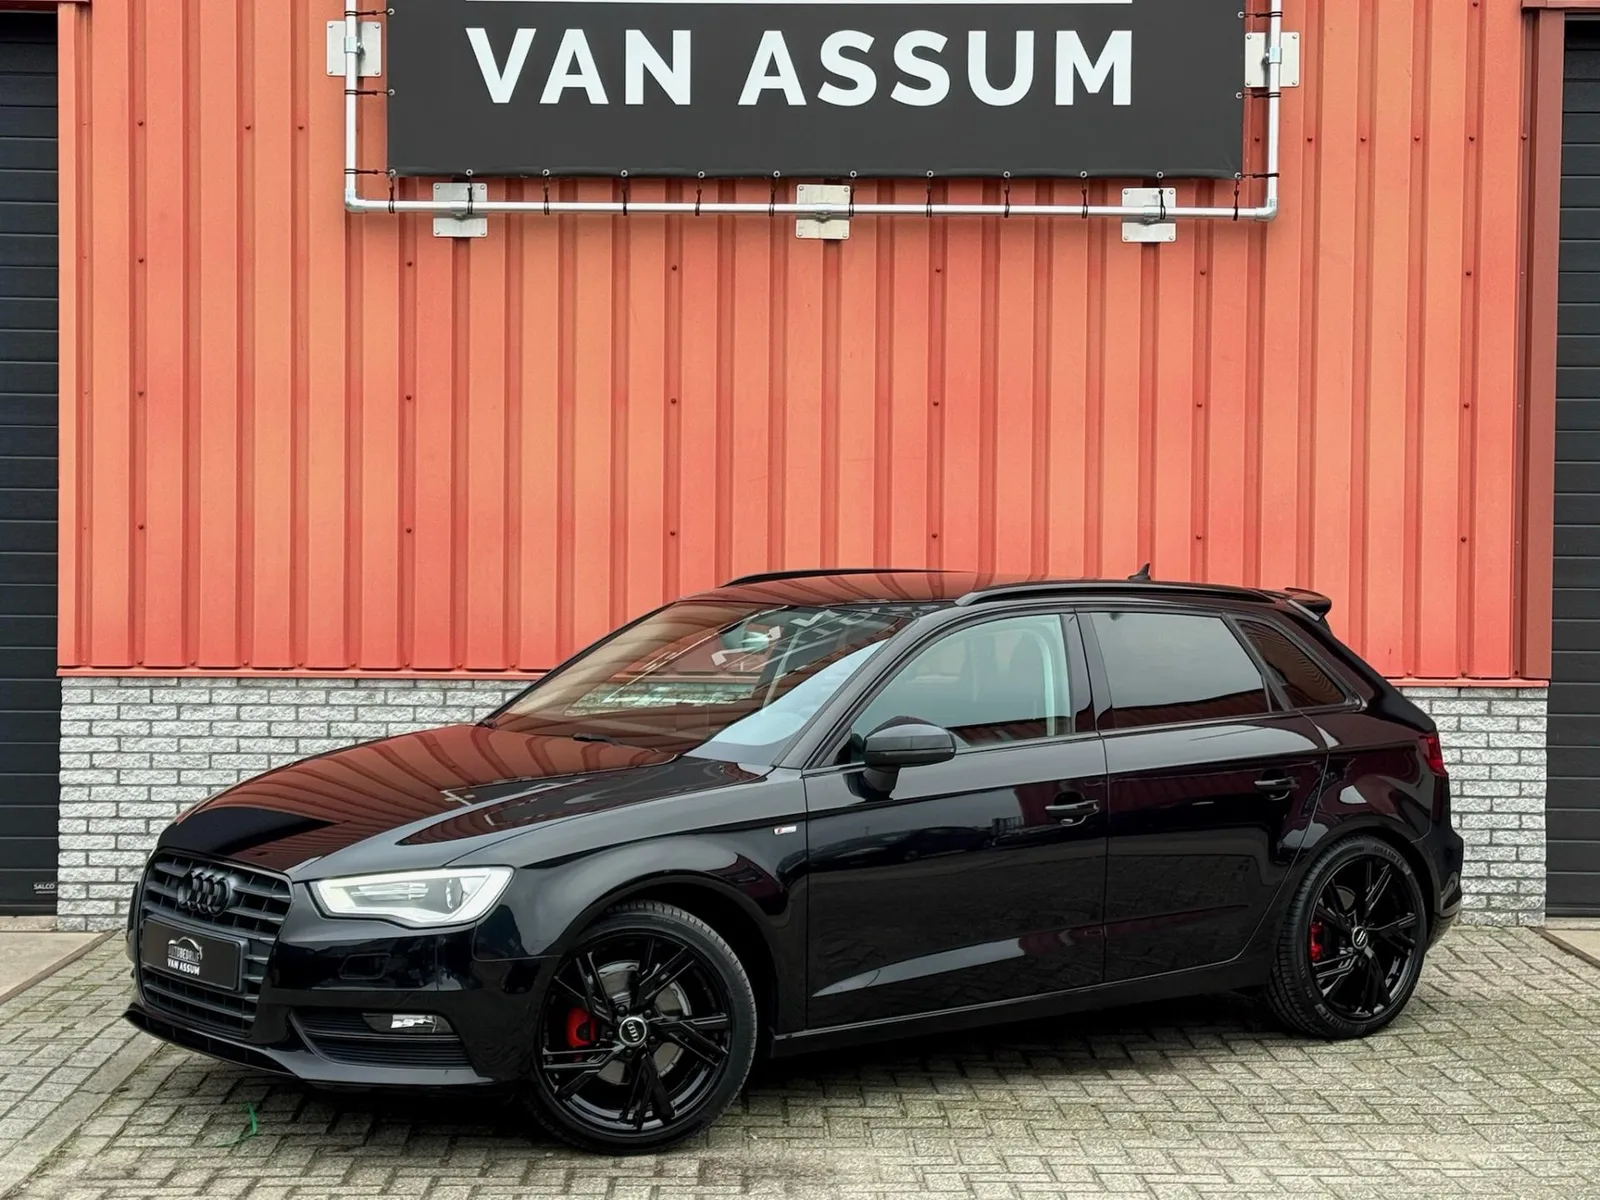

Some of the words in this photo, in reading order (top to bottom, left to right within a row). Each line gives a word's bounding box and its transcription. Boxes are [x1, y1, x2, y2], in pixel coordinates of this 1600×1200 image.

[465, 28, 692, 105] VAN
[737, 29, 1132, 107] ASSUM
[168, 958, 179, 969] VAN
[179, 962, 200, 975] ASSUM
